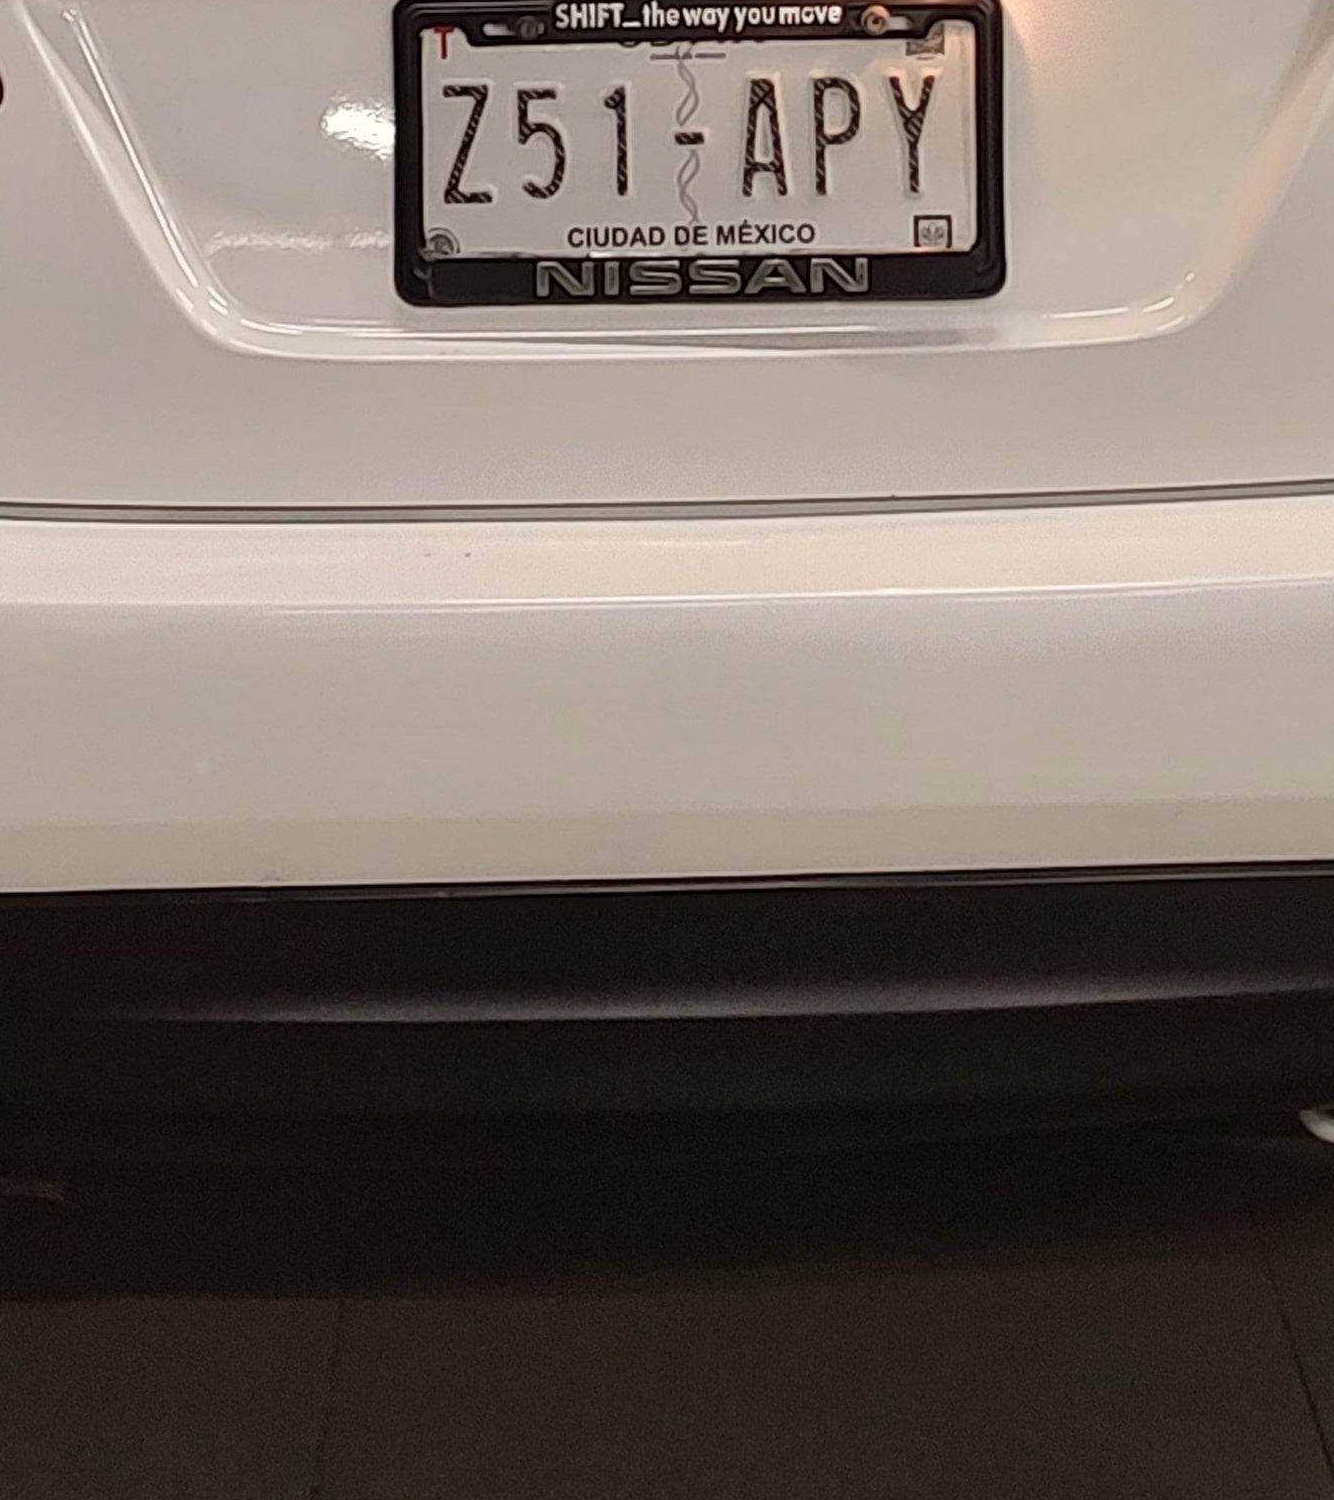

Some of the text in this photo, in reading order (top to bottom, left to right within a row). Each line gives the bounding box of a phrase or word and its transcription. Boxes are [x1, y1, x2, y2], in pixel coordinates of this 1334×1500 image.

[683, 6, 728, 33] way
[734, 6, 775, 33] you
[779, 5, 843, 25] move
[442, 75, 936, 204] Z51-APY
[567, 219, 816, 248] CIUDAD DE MÉXICO
[536, 257, 868, 297] NISSAN
